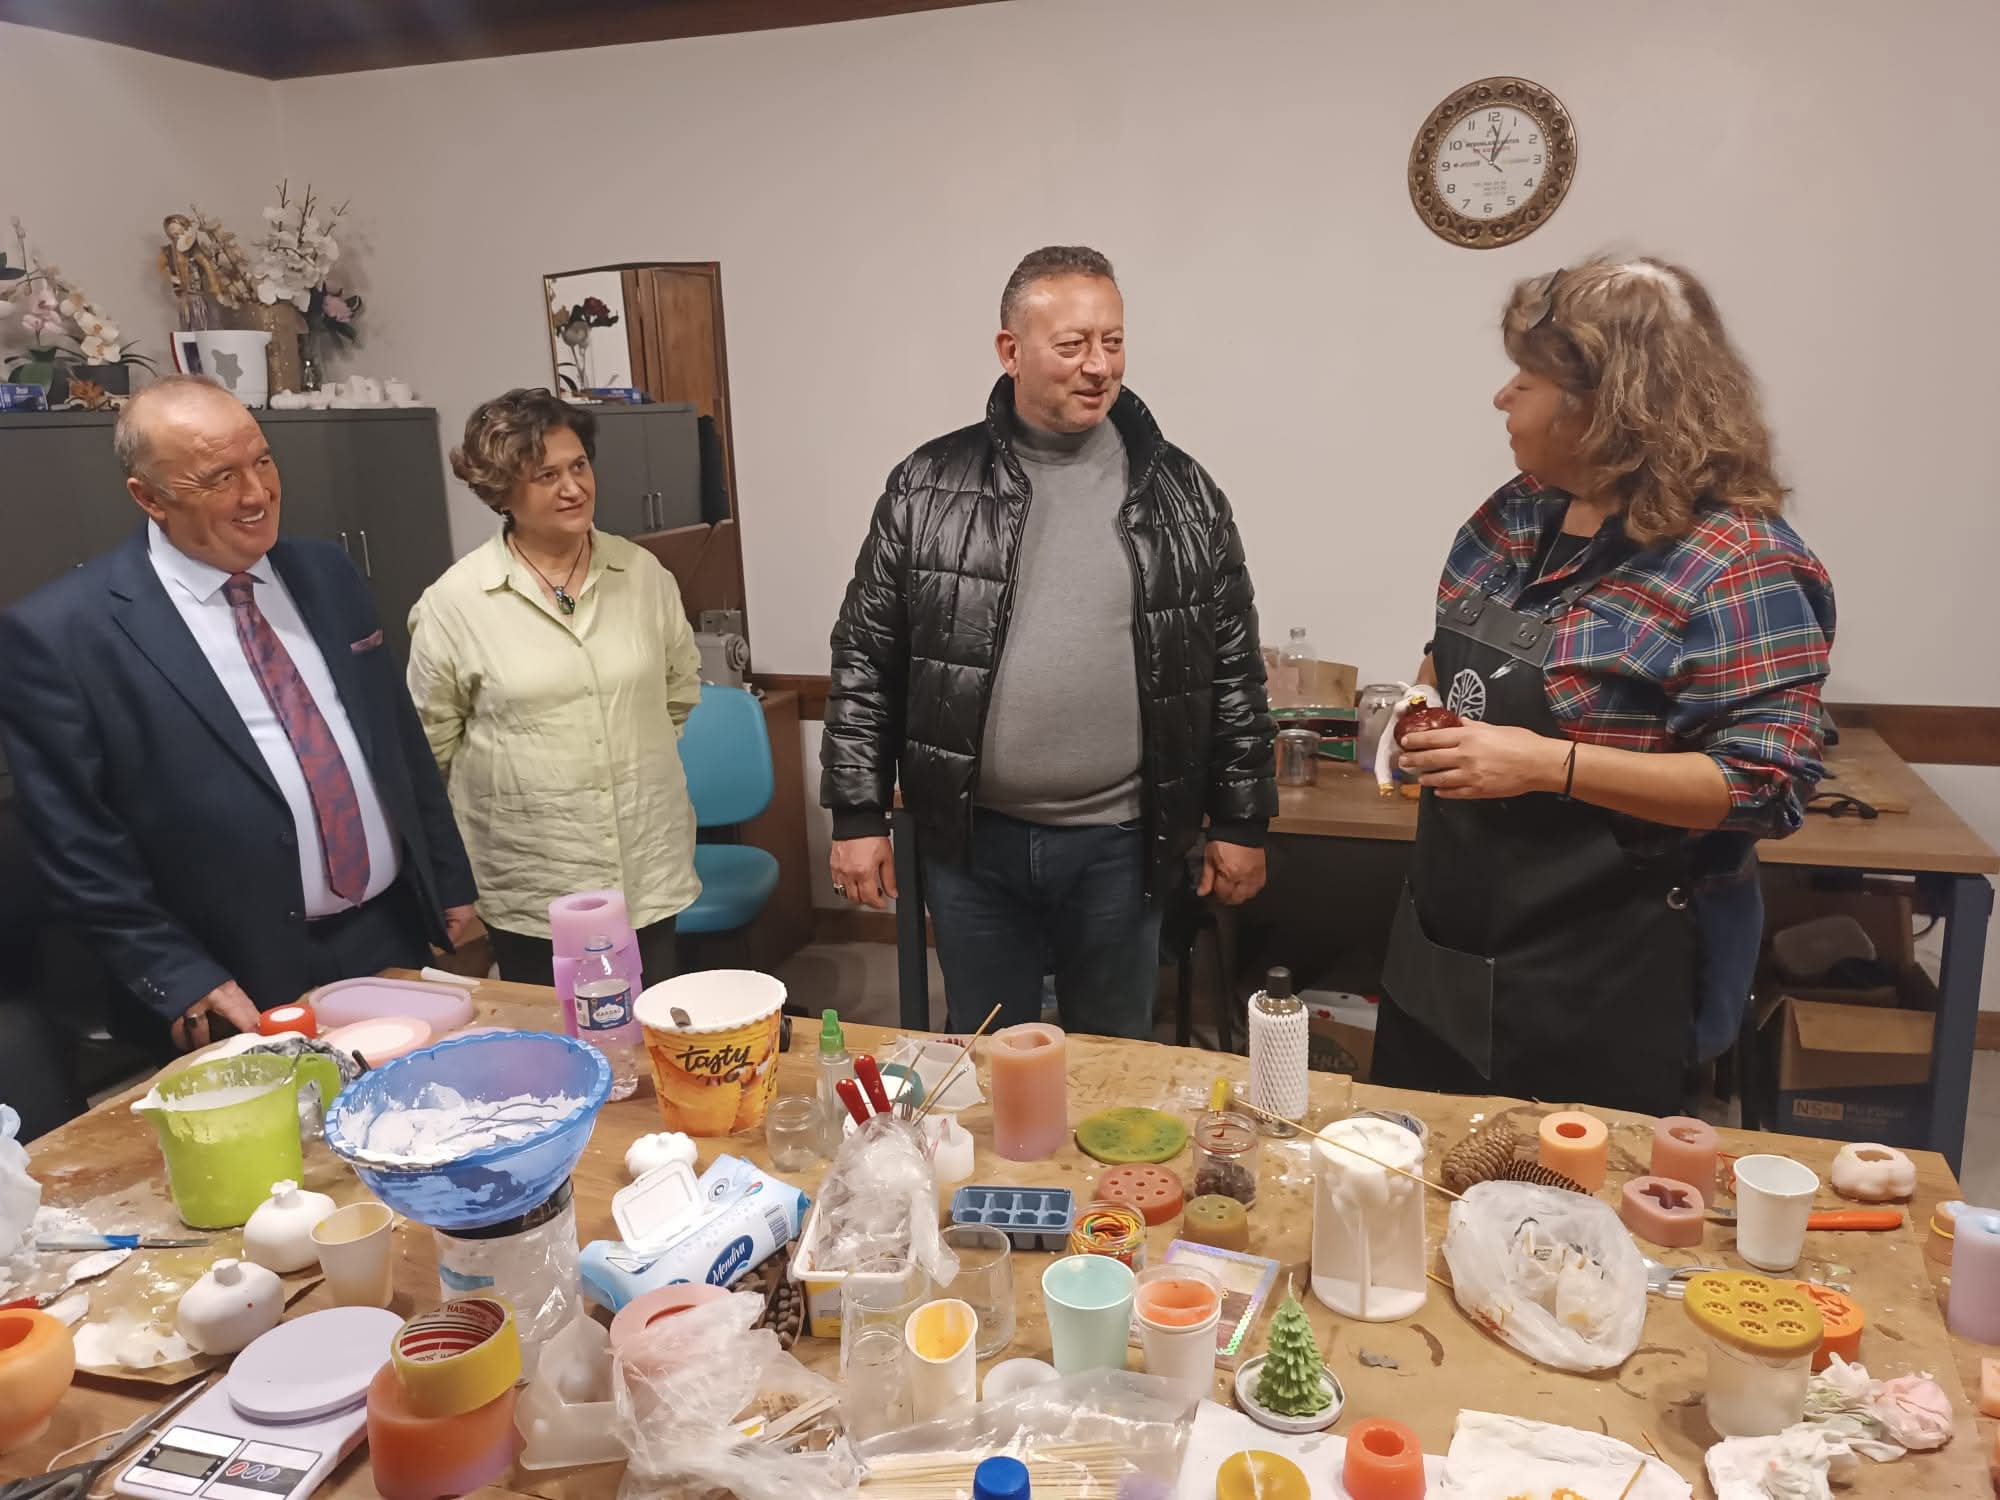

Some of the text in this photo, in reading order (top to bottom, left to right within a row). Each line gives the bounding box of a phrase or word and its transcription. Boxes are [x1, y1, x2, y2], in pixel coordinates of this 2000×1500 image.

[1488, 112, 1501, 122] 12
[1514, 116, 1518, 127] 1
[1468, 120, 1475, 131] 11
[1528, 134, 1538, 145] 2
[1449, 140, 1462, 151] 10
[1532, 154, 1542, 165] 3
[1441, 161, 1450, 172] 9
[1523, 178, 1533, 187] 4
[1447, 184, 1456, 194] 8
[1462, 199, 1471, 209] 7
[1506, 195, 1516, 206] 5
[1483, 203, 1492, 213] 6
[675, 1044, 755, 1083] tasty
